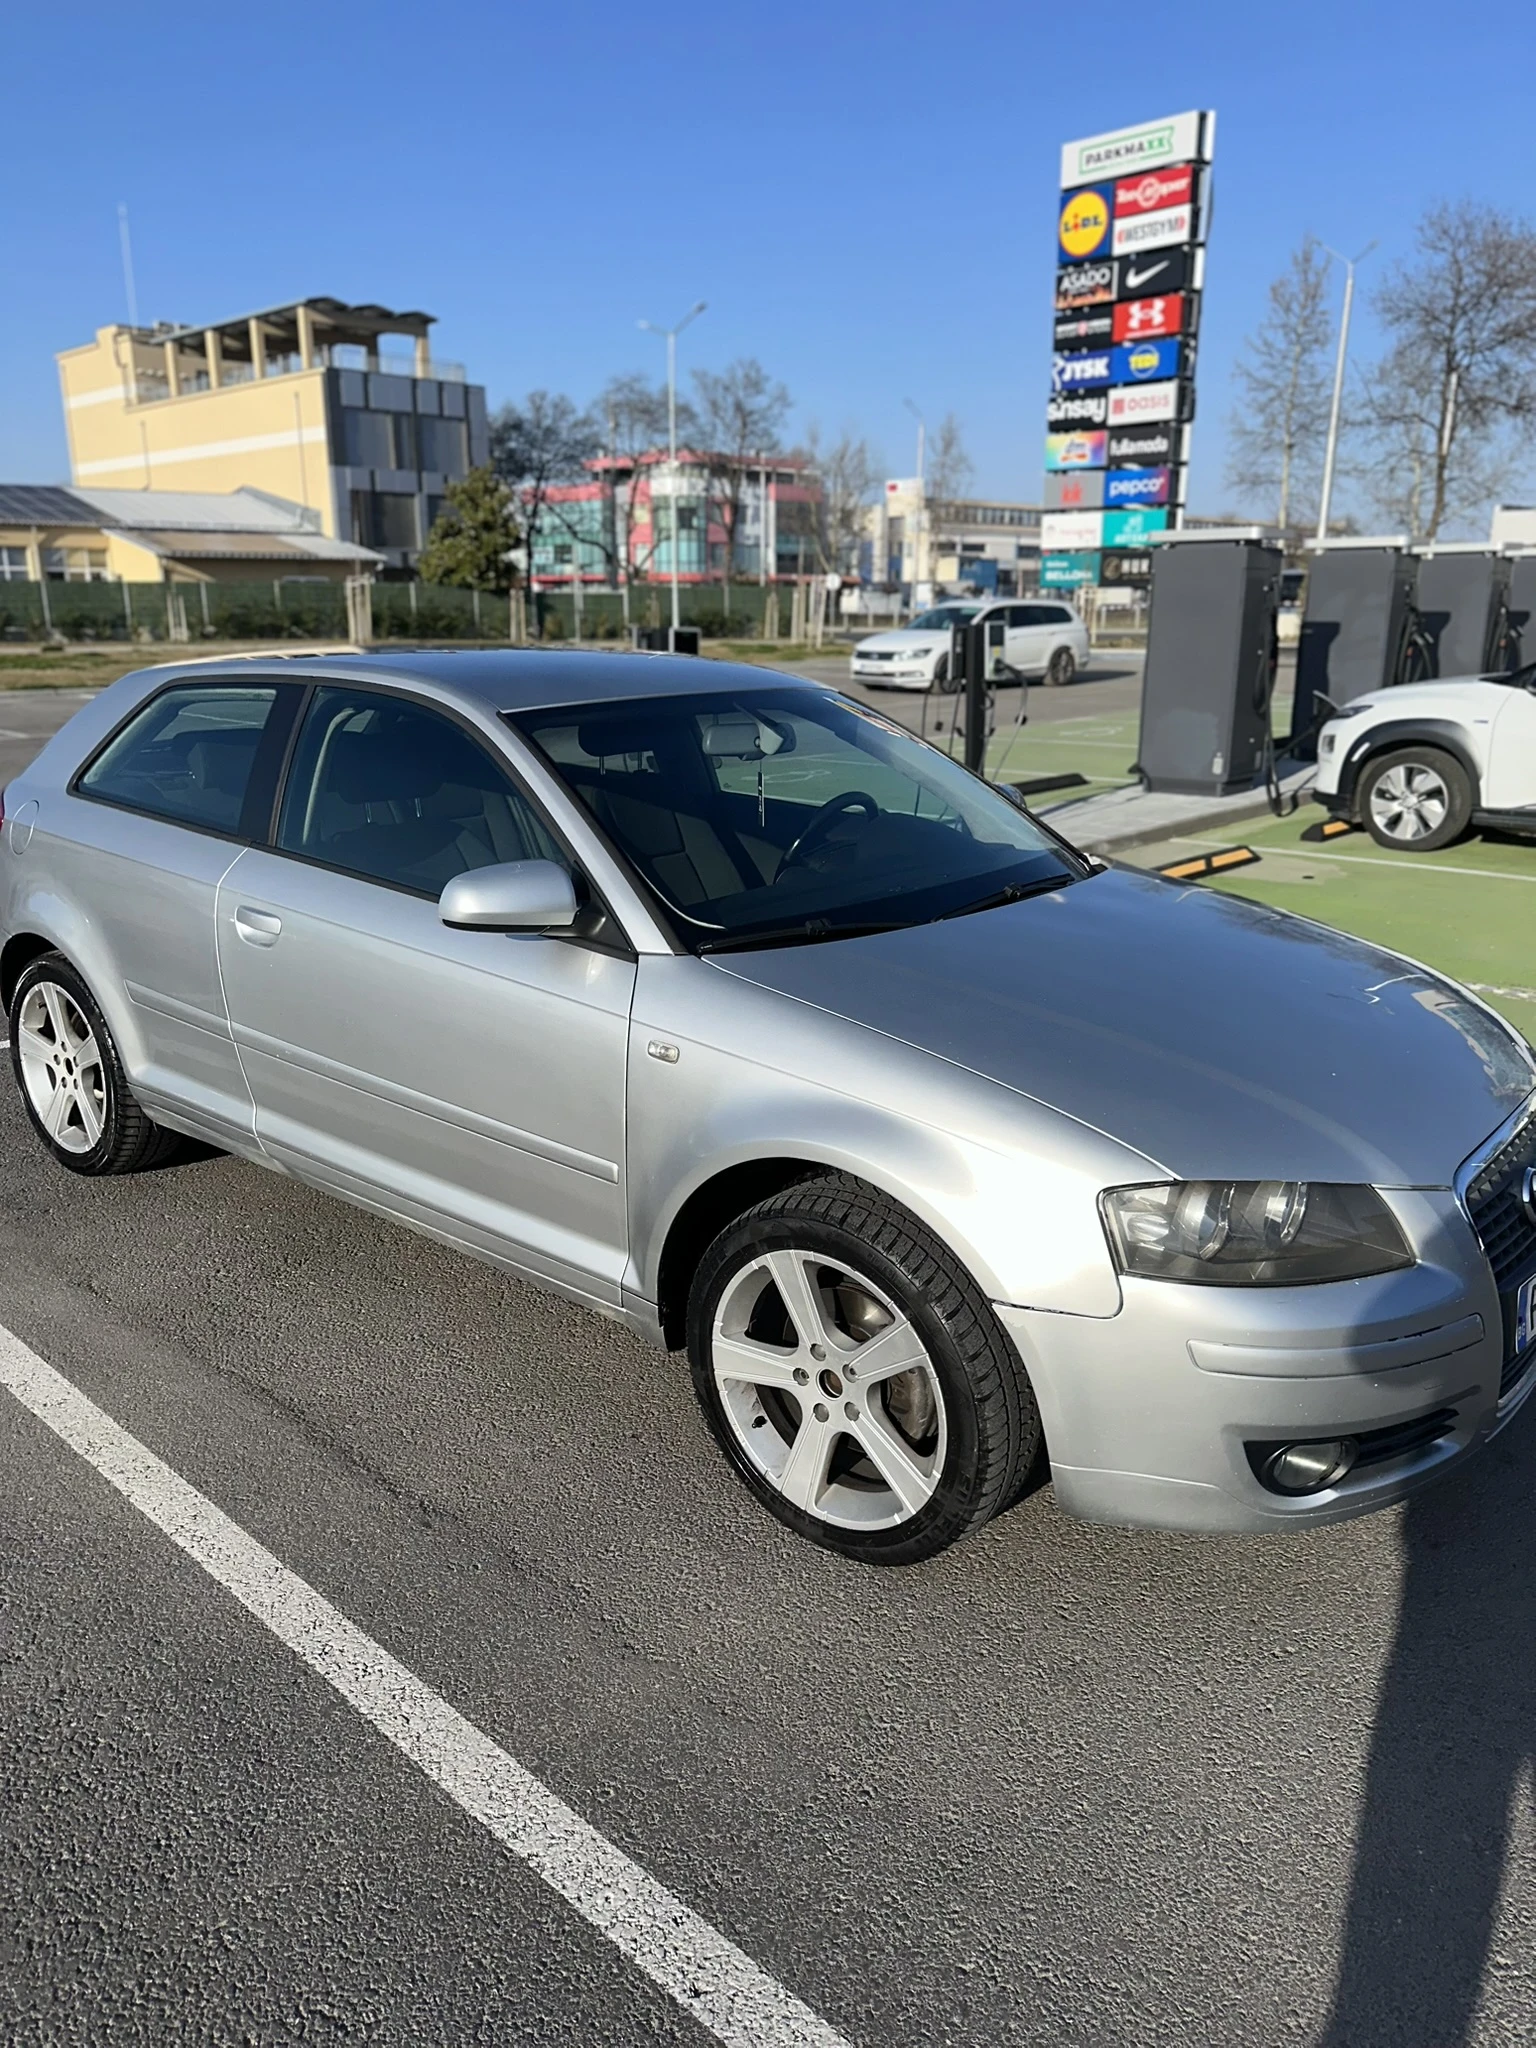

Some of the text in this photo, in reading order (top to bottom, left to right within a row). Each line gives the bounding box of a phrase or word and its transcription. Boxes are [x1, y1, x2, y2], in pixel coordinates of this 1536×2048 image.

[1085, 138, 1165, 165] PARKMAXX
[1060, 267, 1111, 292] ASADO
[1062, 356, 1109, 382] JYSK
[1047, 397, 1106, 423] sinsay
[1109, 477, 1165, 498] pepco
